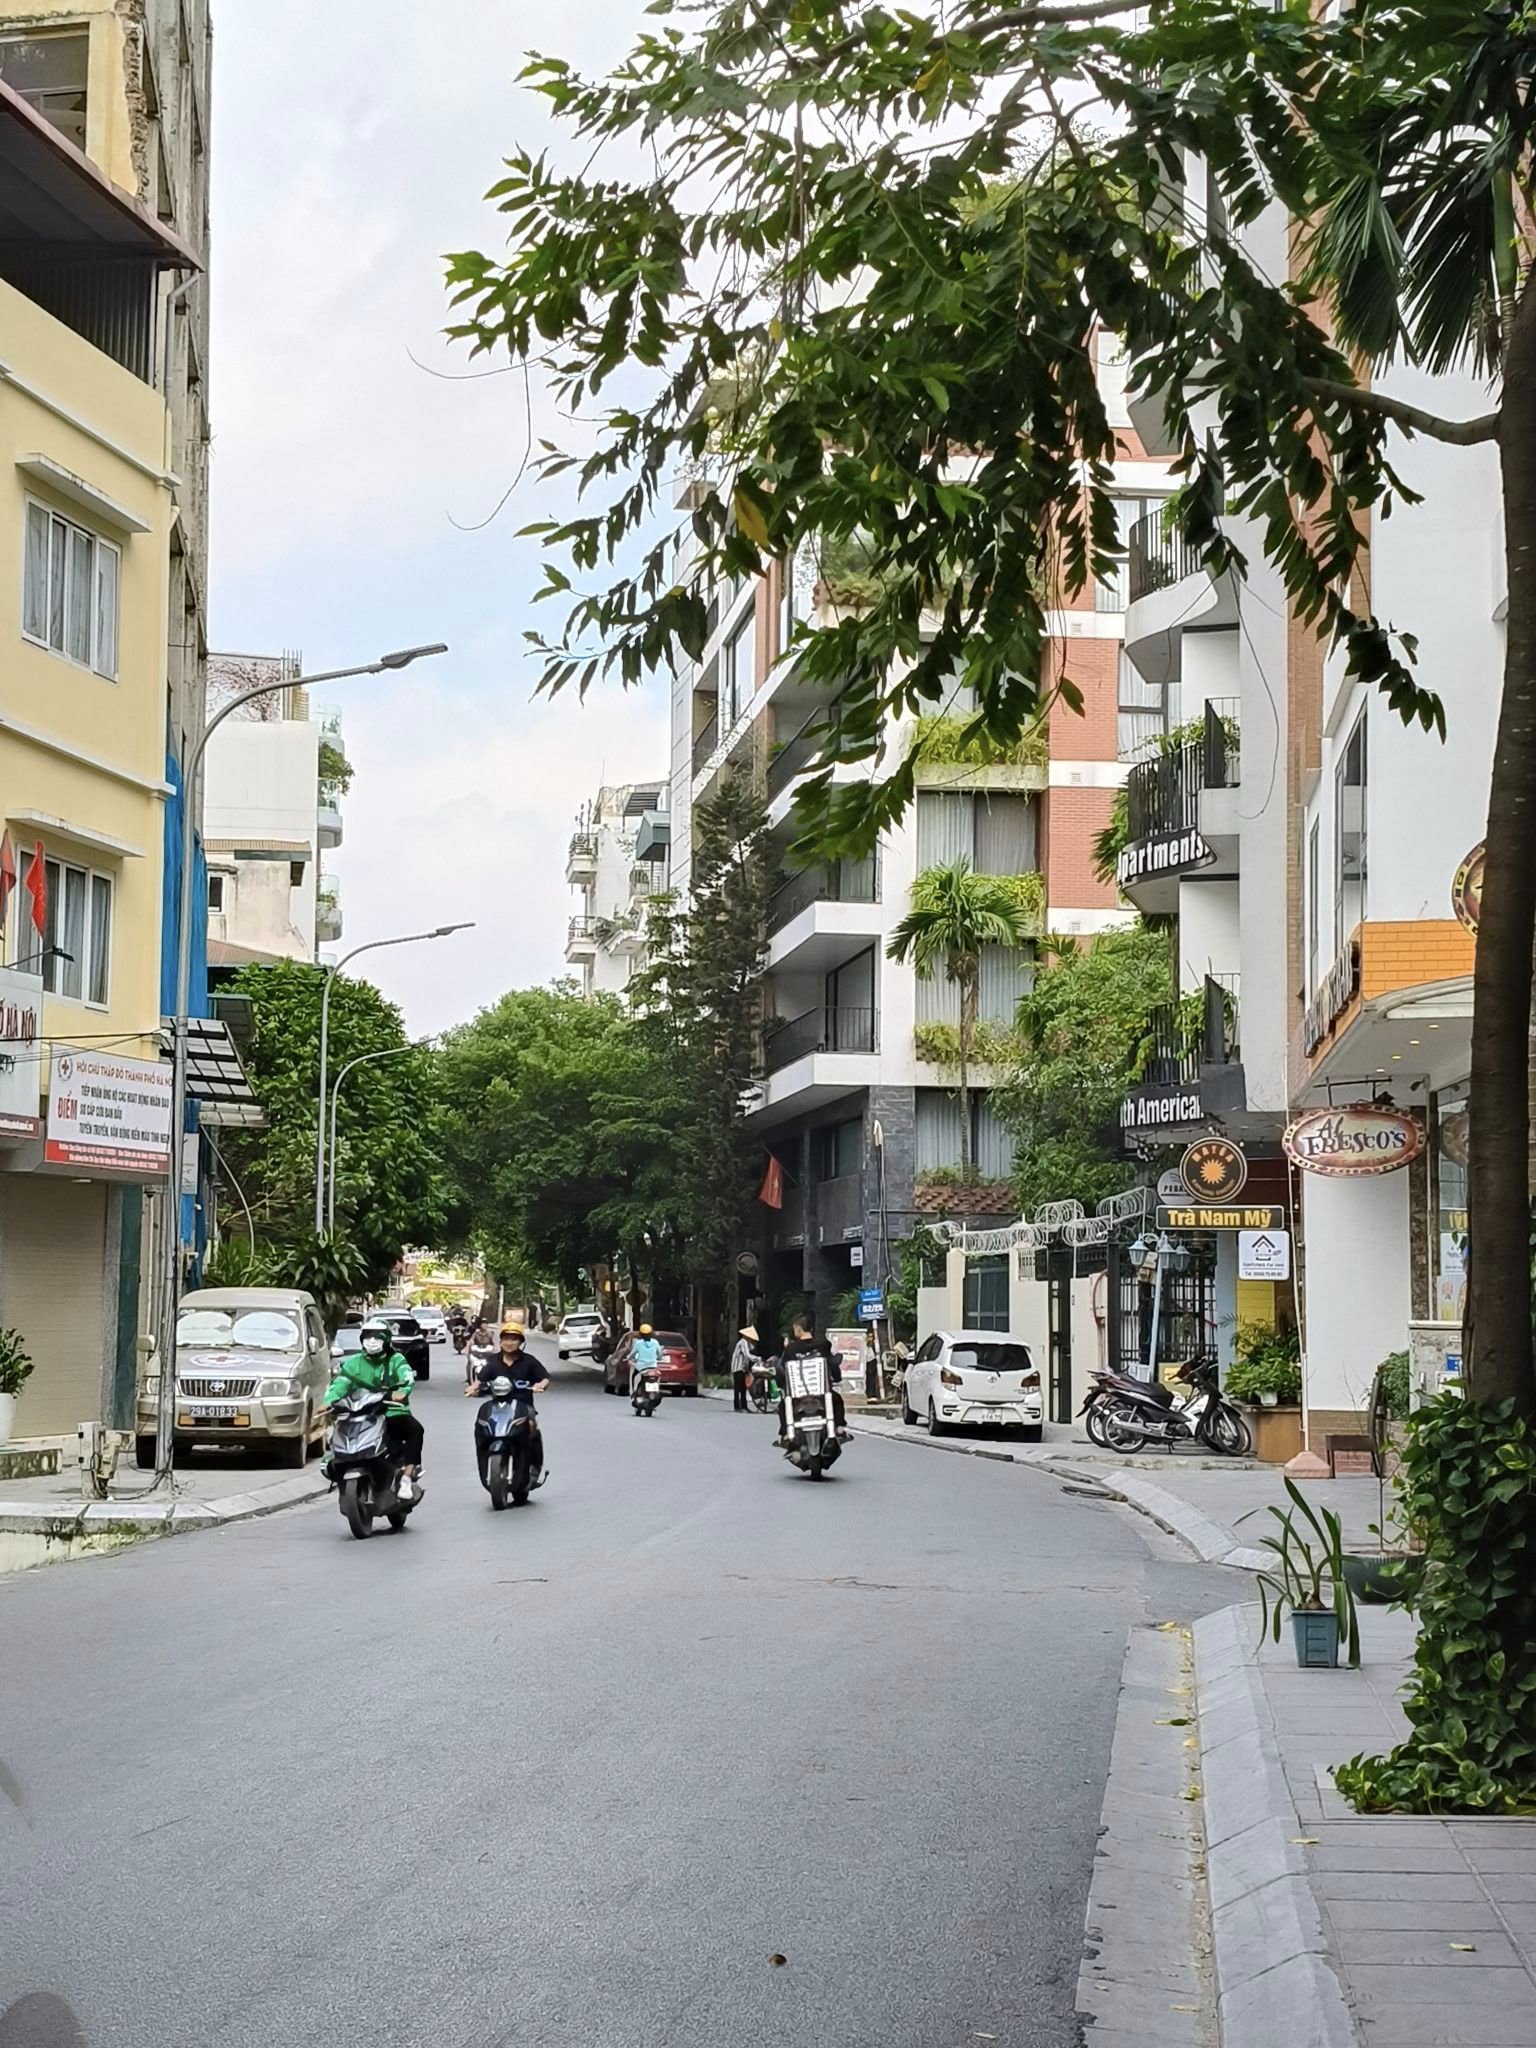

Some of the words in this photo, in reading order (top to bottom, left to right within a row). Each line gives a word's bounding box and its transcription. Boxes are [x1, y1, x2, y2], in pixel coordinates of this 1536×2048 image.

[1167, 1208, 1196, 1226] Trà
[1200, 1210, 1239, 1226] Nam
[1244, 1208, 1272, 1228] Mỹ
